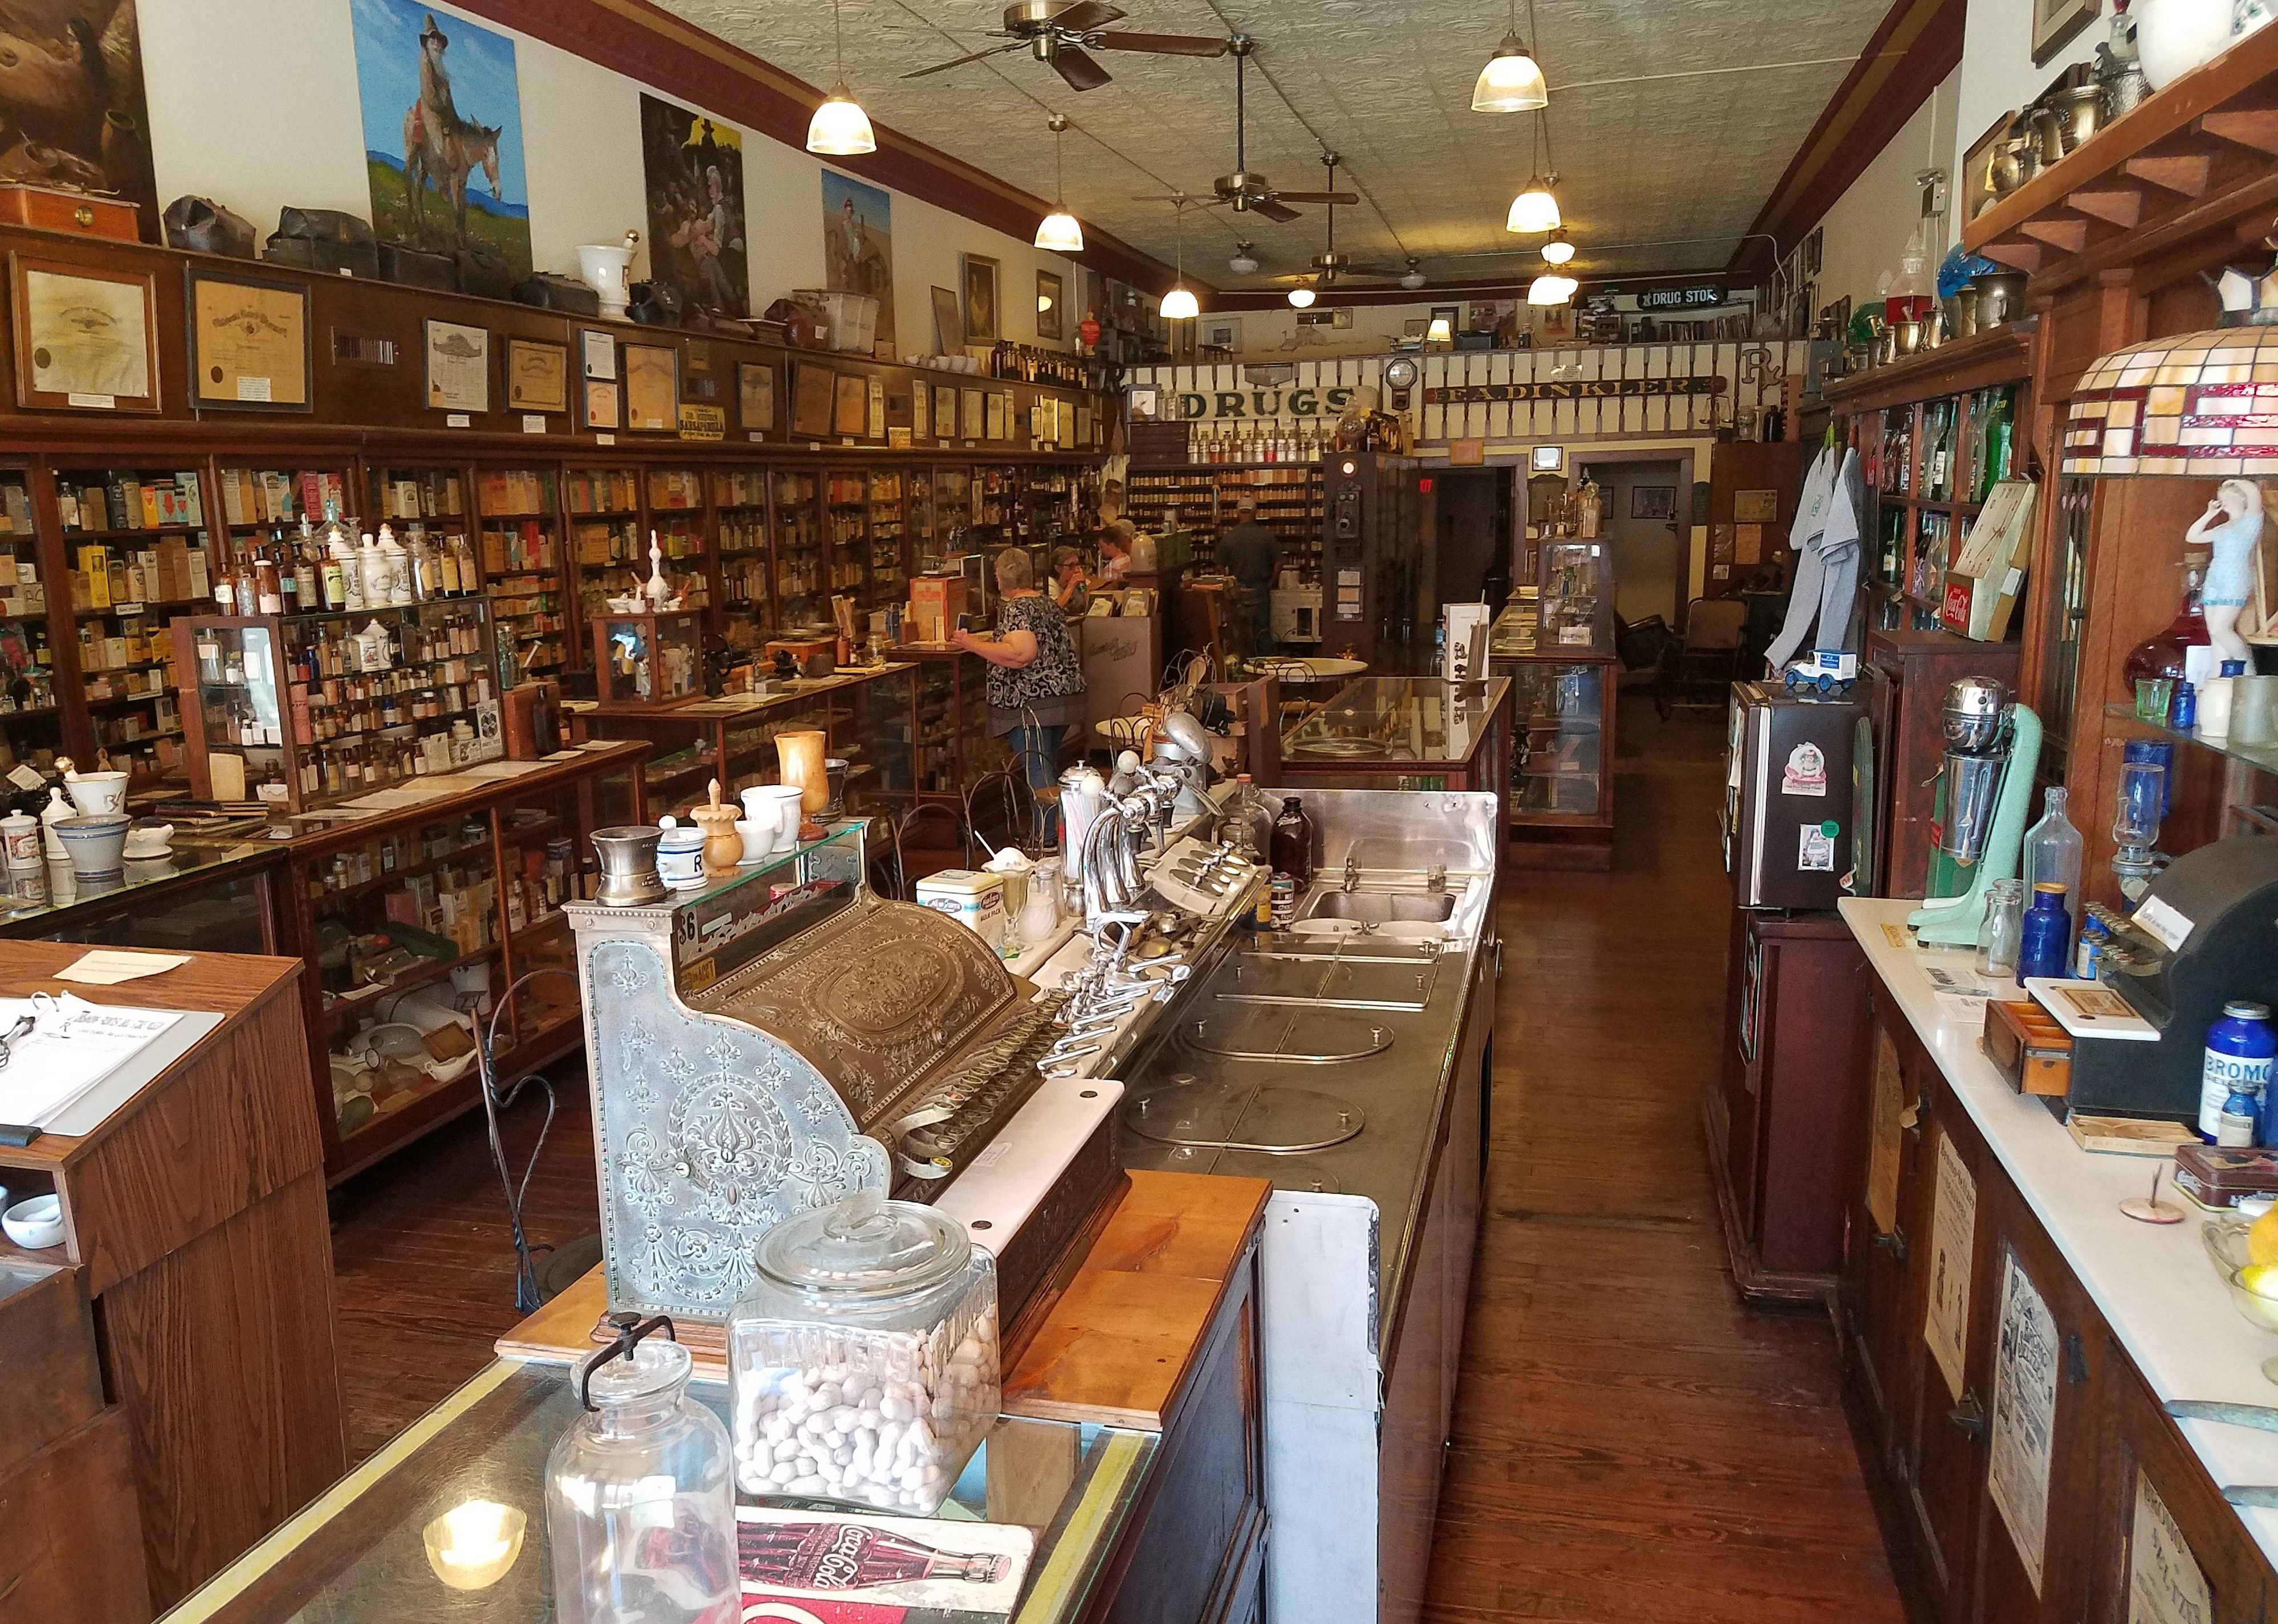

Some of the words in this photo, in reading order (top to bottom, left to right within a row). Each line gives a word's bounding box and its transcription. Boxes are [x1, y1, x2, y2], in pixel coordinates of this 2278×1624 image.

[1653, 291, 1682, 305] DRUG
[1686, 289, 1718, 304] STO
[1506, 379, 1689, 399] DINKLER
[1177, 387, 1354, 419] DRUGS
